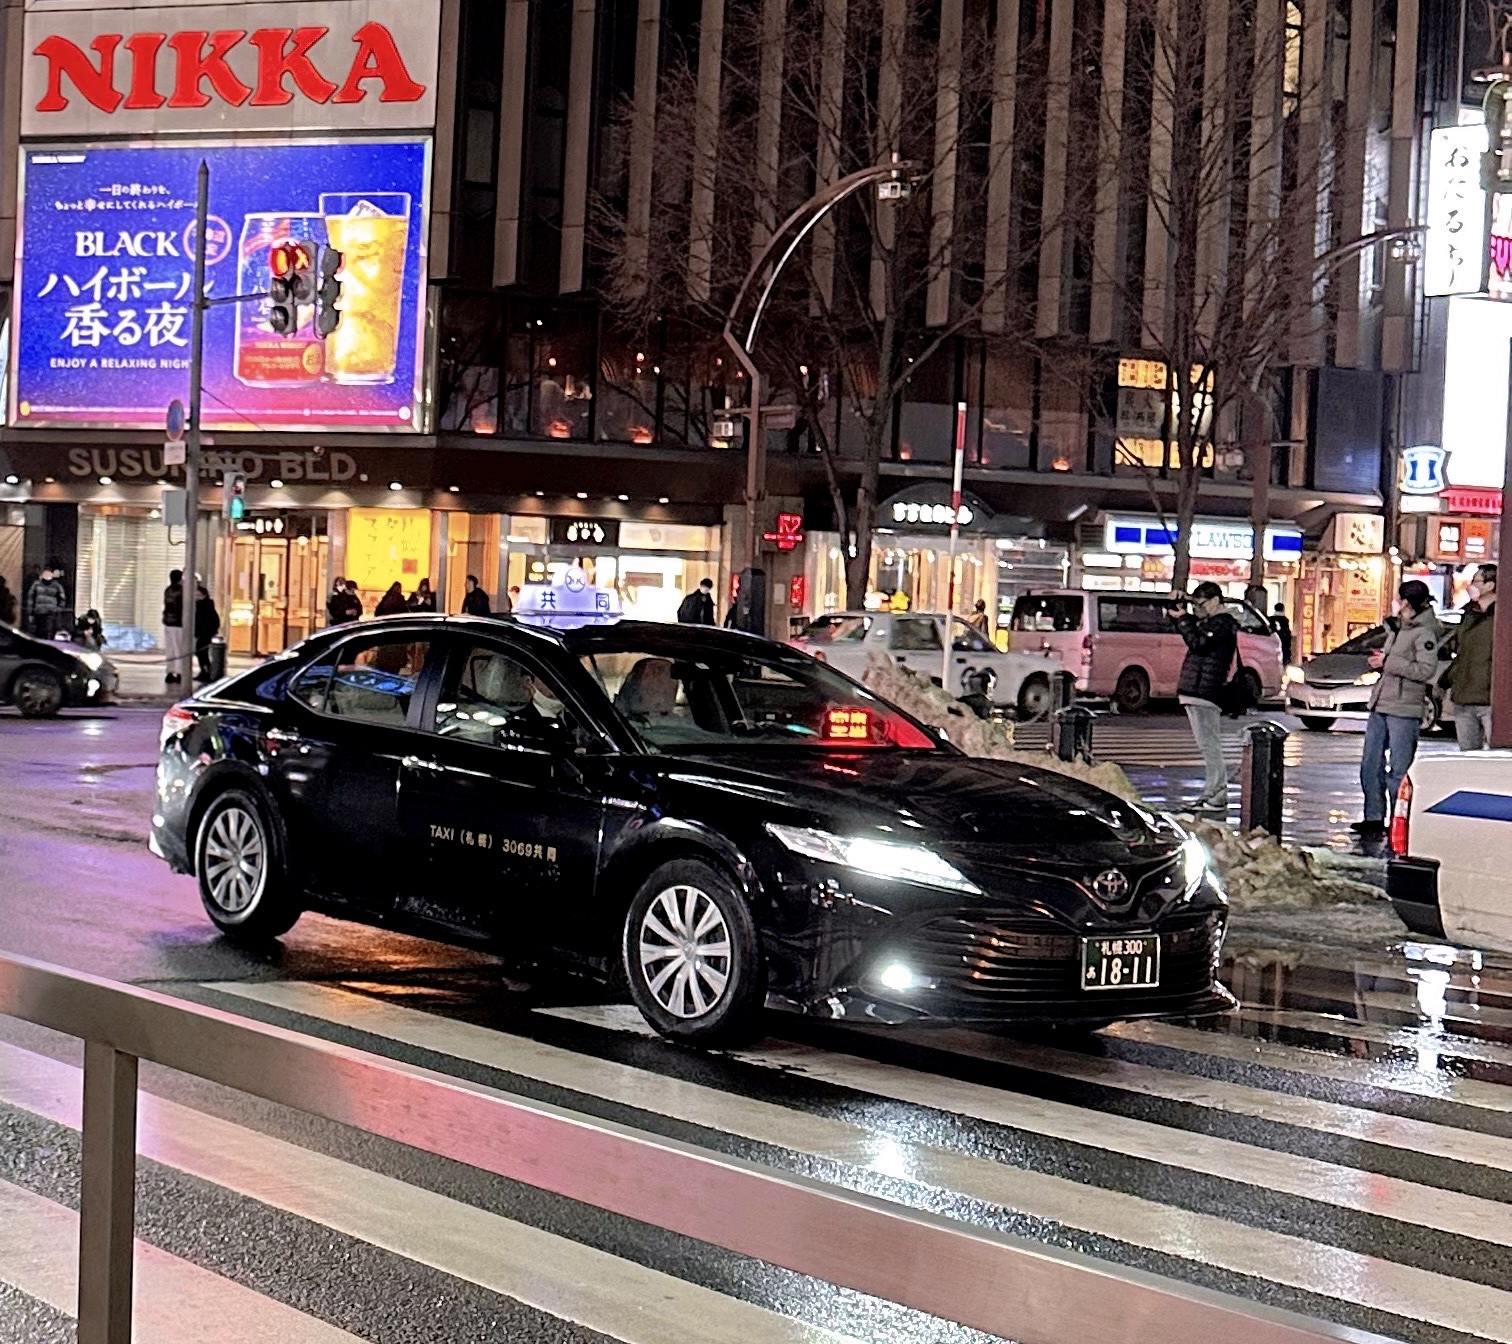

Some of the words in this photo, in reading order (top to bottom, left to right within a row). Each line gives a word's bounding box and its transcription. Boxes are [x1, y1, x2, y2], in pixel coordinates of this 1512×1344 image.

[31, 20, 427, 114] NIKKA
[54, 198, 199, 212] ちょっと幸せにしてくれるハイボー
[75, 231, 180, 257] BLACK
[60, 301, 189, 348] 香る夜
[50, 358, 87, 369] ENJOY
[90, 359, 98, 369] A
[101, 358, 157, 370] RELAXING
[160, 359, 192, 369] NIGH
[69, 448, 265, 480] SUSUINO
[1194, 529, 1255, 550] LAWSO
[540, 589, 611, 612] 共同
[430, 824, 454, 841] TAXI
[1100, 955, 1151, 986] 18-11
